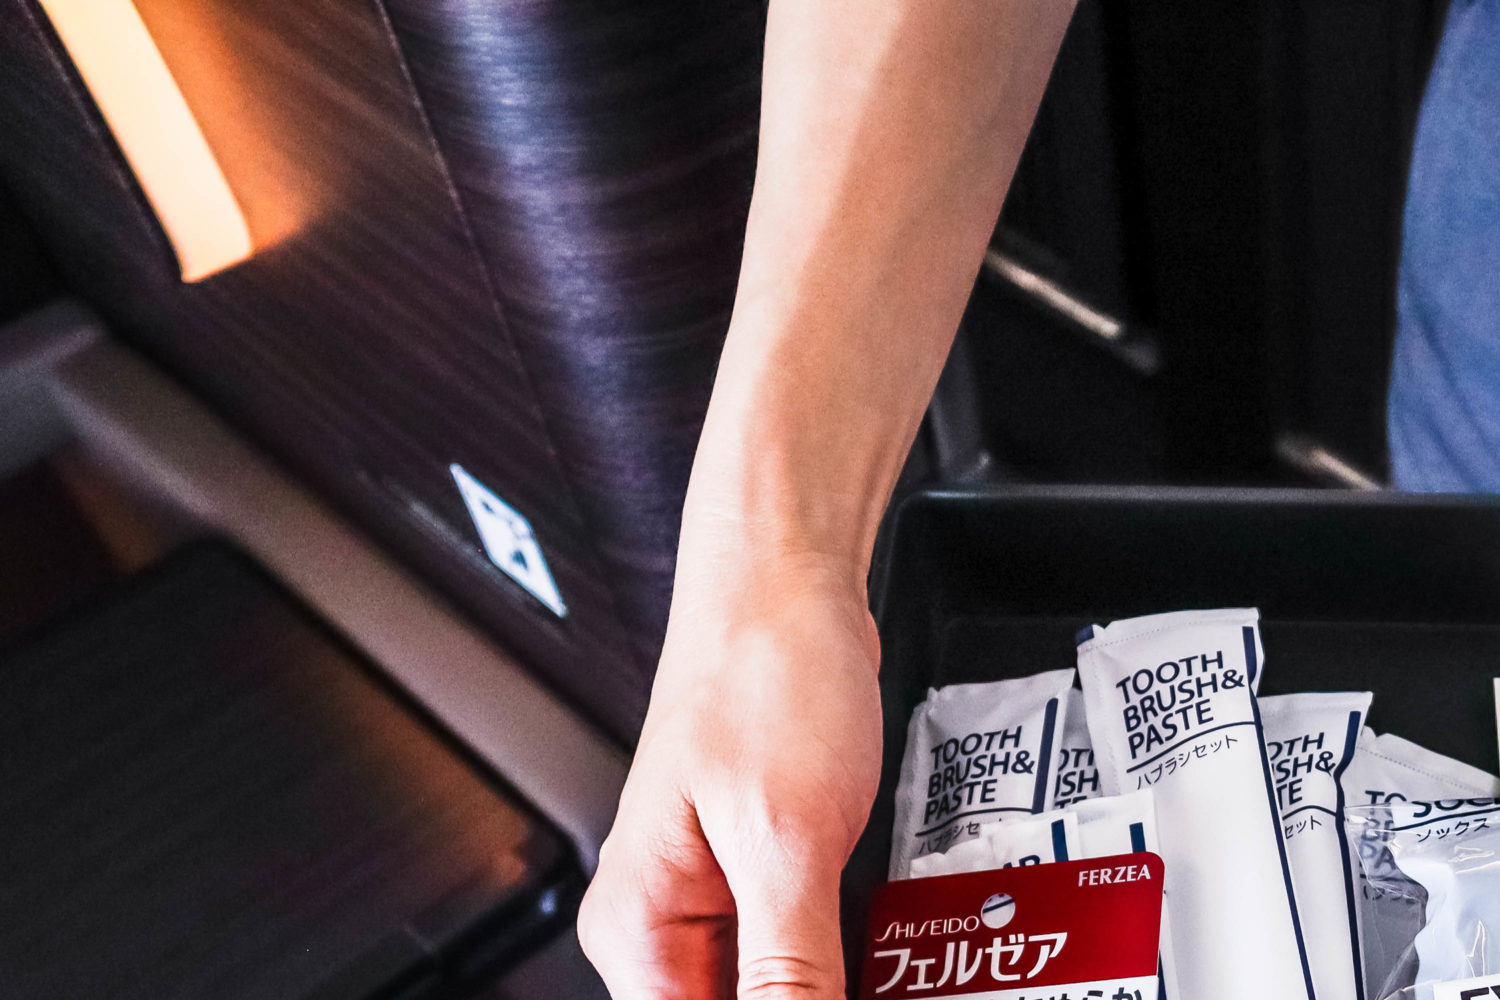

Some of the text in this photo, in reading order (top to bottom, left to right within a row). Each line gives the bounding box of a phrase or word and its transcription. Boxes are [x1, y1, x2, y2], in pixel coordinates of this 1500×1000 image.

[1116, 650, 1224, 703] TOOTH
[1122, 668, 1246, 733] BRUSH&
[931, 725, 1022, 770] TOOTH
[1128, 699, 1216, 760] PASTE
[927, 750, 1035, 798] BRUSH&
[1135, 734, 1239, 791] ハブラシセット
[924, 779, 998, 824] PASTE
[1416, 817, 1491, 843] ソックス
[1078, 864, 1151, 887] FERZEA
[875, 915, 980, 942] SHISEIDO
[873, 931, 1069, 994] フェルゼア
